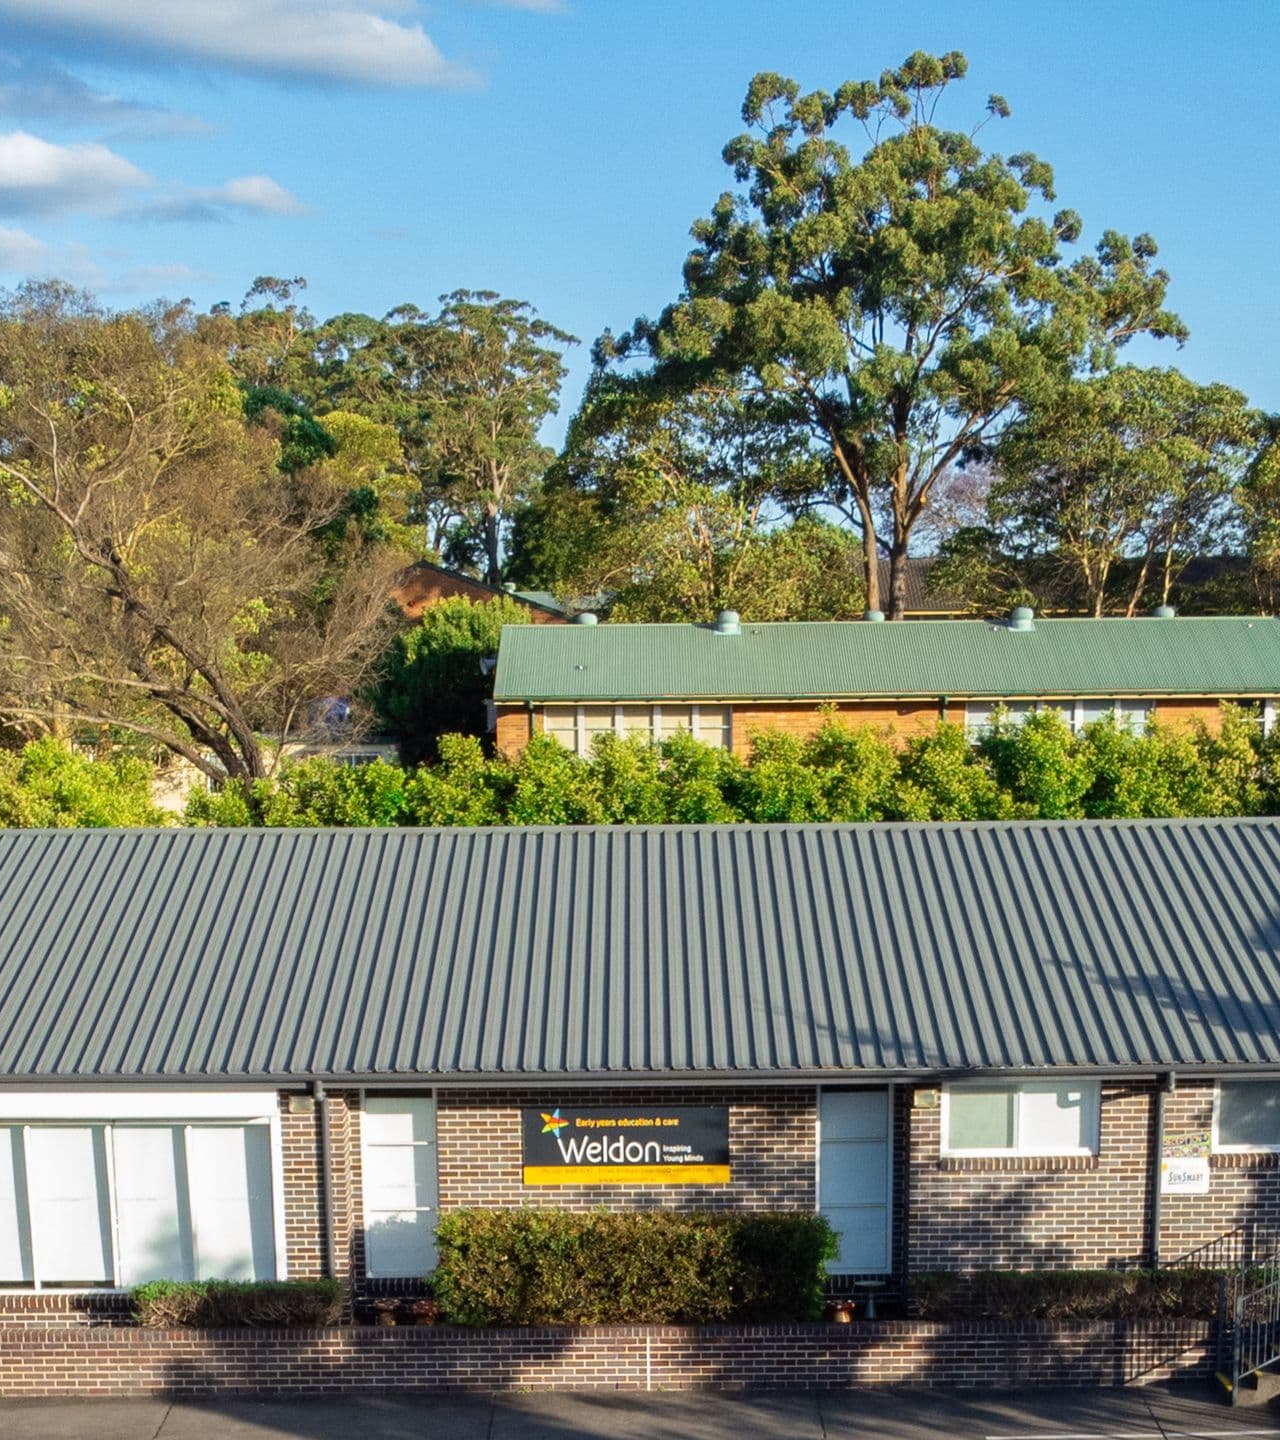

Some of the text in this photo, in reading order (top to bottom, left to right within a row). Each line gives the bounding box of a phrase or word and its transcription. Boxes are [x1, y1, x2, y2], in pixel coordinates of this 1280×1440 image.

[575, 1118, 595, 1128] Early
[596, 1118, 616, 1128] years
[617, 1118, 653, 1127] education
[662, 1118, 679, 1126] care
[557, 1135, 660, 1163] Weldon
[662, 1154, 683, 1163] Young
